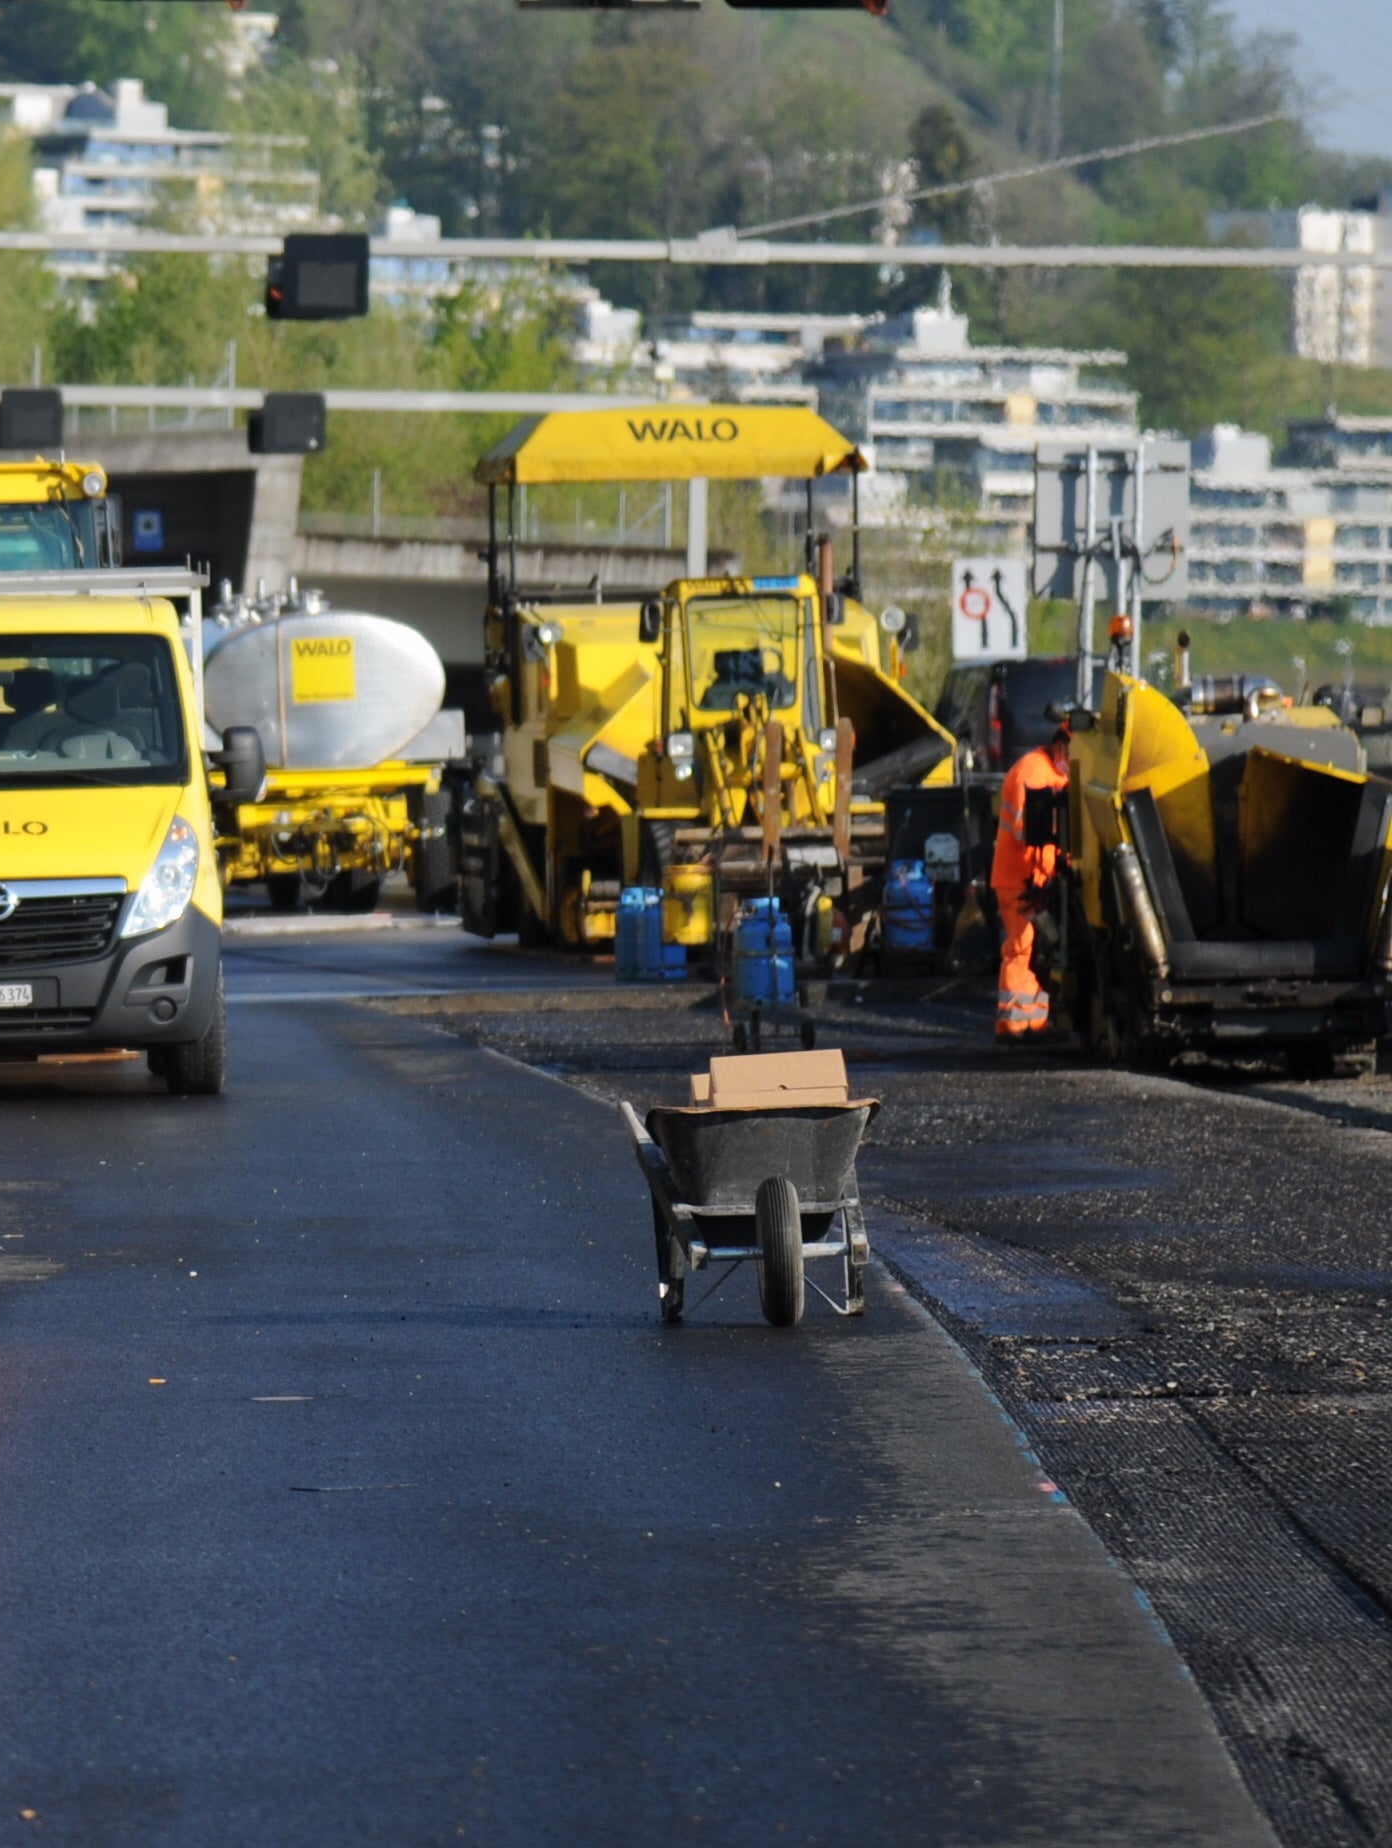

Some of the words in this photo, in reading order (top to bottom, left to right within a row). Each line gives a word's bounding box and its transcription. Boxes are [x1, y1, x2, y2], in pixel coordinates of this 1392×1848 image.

[627, 419, 739, 441] WALO
[294, 640, 351, 657] WALO
[8, 986, 30, 1001] 374
